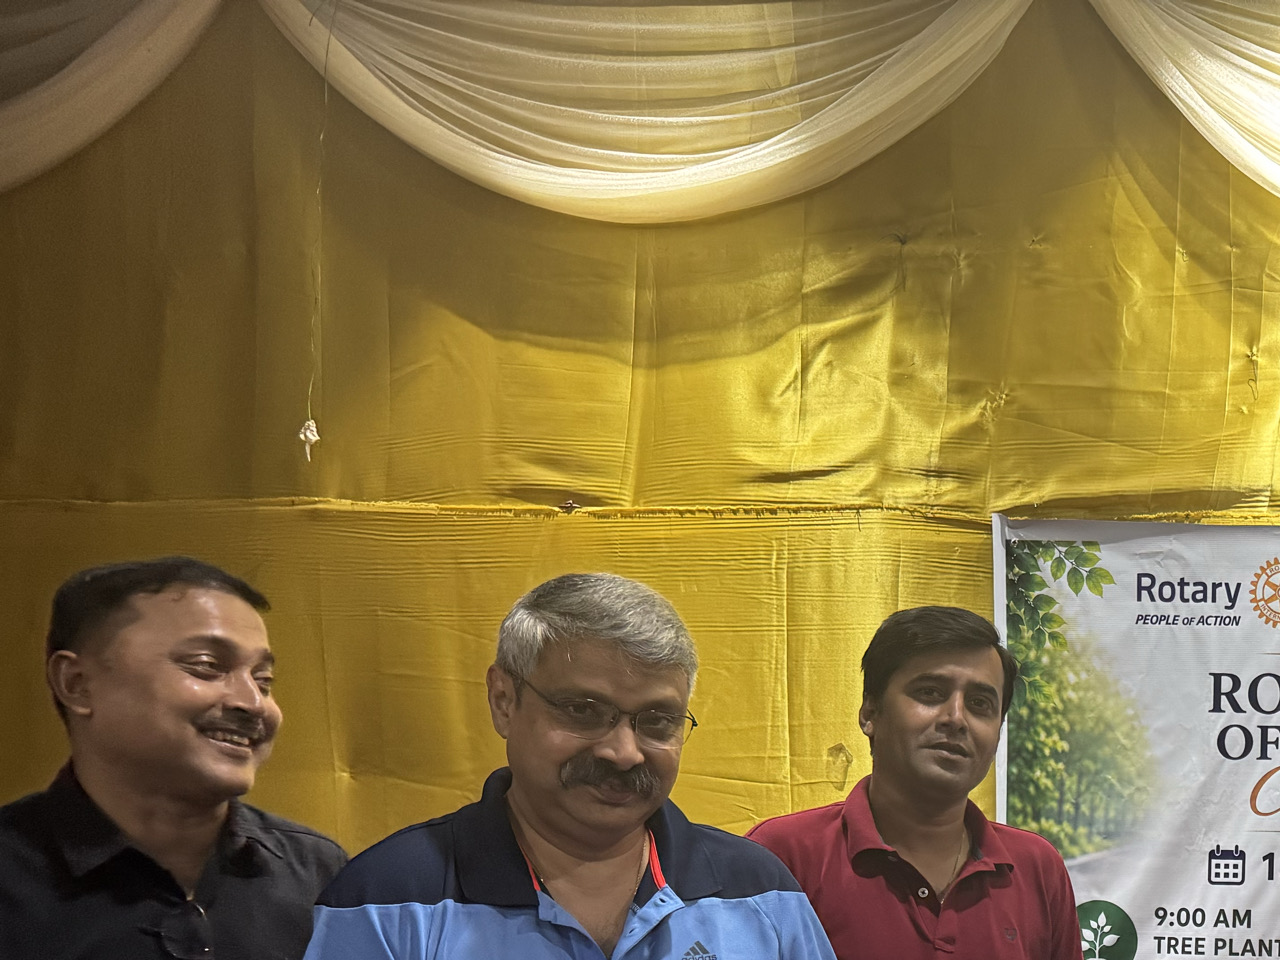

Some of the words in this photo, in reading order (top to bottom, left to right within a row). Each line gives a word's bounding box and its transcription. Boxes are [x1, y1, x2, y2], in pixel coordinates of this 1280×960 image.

[1136, 572, 1242, 610] Rotary
[1135, 614, 1180, 626] PEOPLE
[1196, 615, 1241, 627] ACTION
[1154, 907, 1206, 927] 9:00
[1213, 908, 1252, 929] AM
[1153, 936, 1206, 956] TREE
